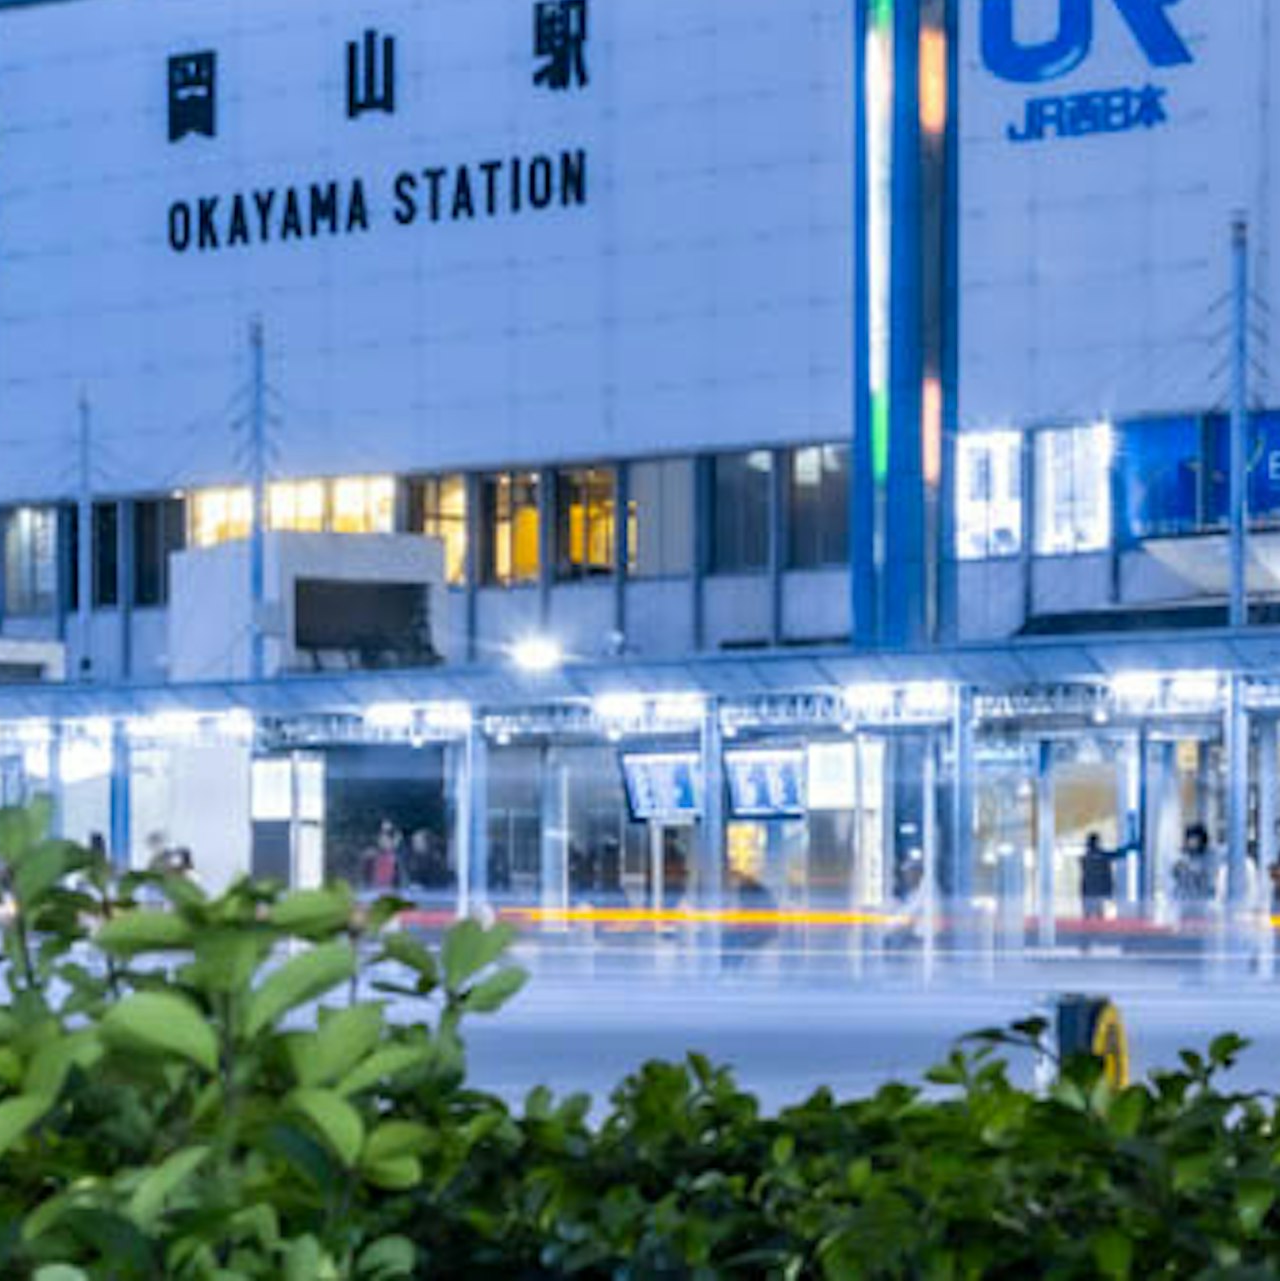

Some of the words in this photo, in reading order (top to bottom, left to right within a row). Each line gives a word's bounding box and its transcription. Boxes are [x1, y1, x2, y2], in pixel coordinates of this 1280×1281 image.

[1006, 83, 1168, 143] JR西日本
[168, 178, 369, 253] OKAYAMA
[393, 149, 586, 226] STATION
